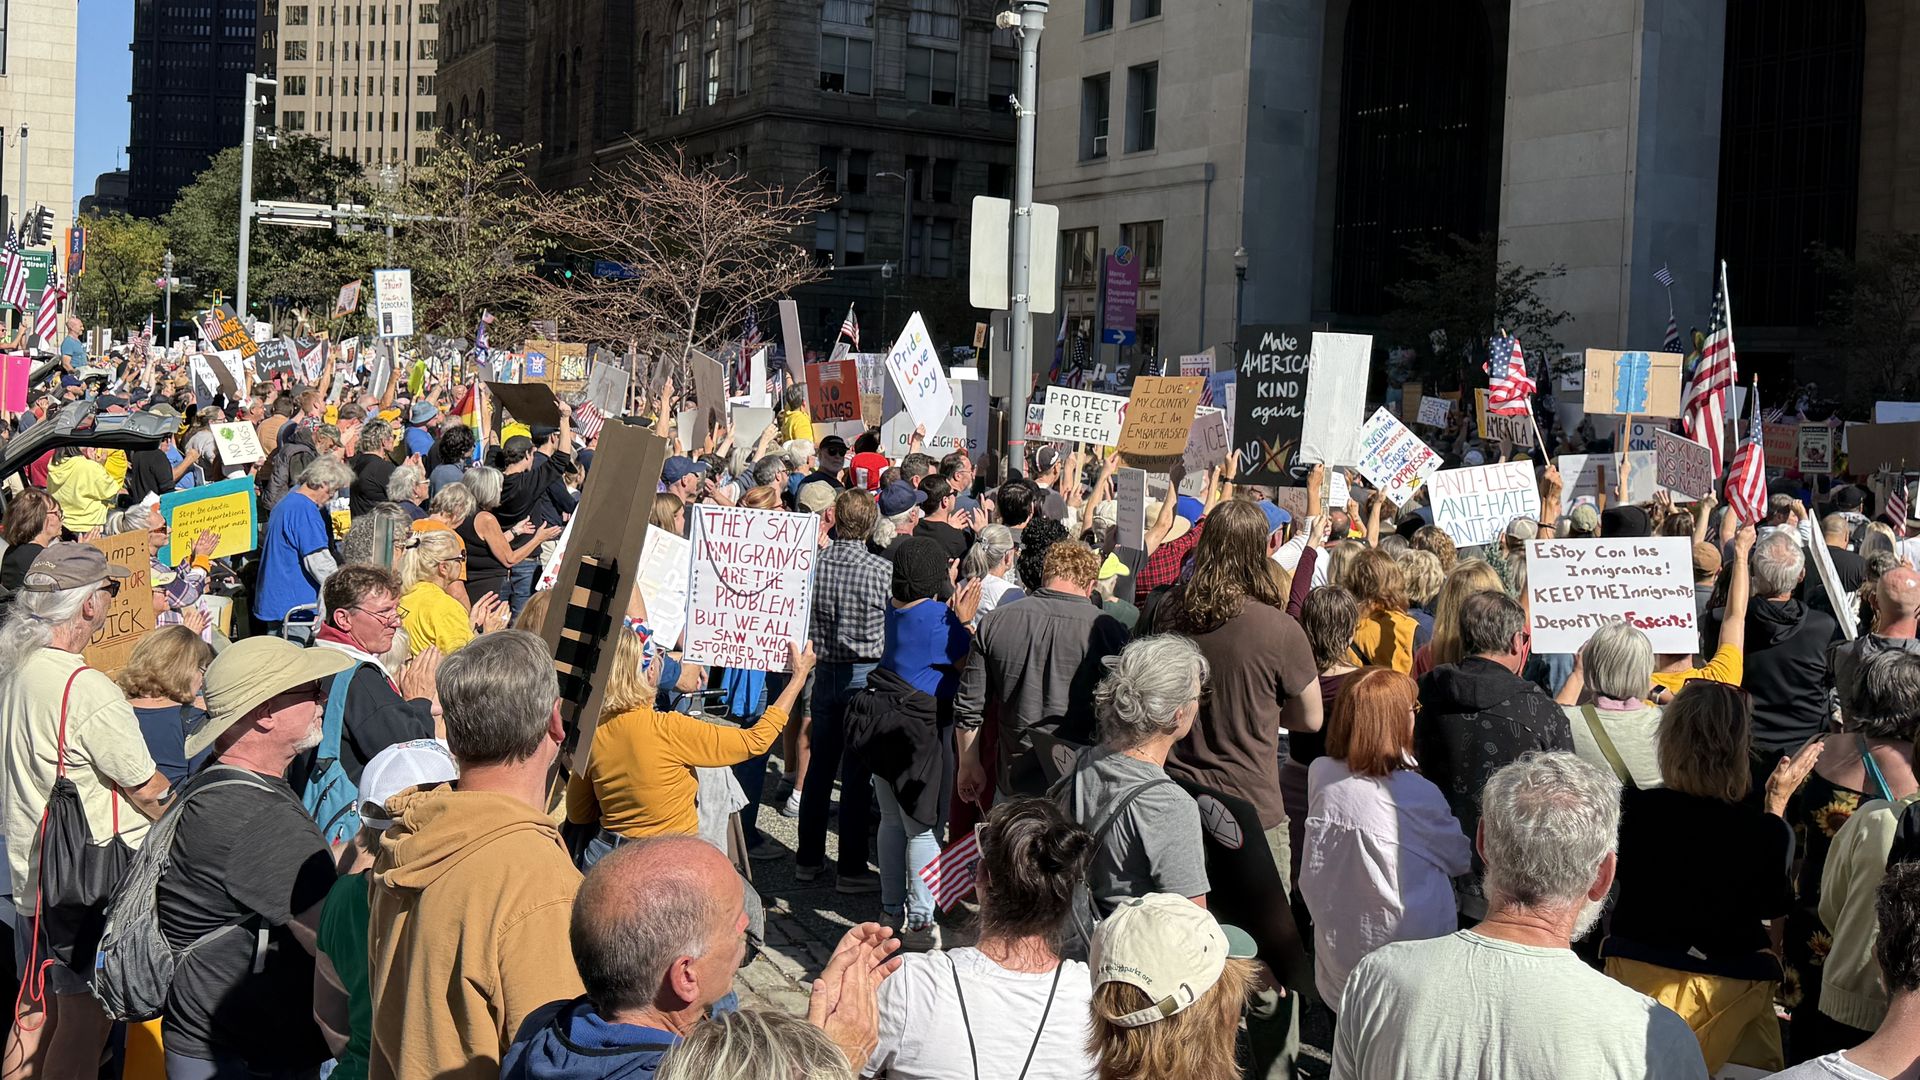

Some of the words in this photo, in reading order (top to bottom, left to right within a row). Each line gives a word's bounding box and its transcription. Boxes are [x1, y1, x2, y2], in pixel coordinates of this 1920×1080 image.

[1108, 270, 1126, 279] Mercy
[1107, 297, 1135, 306] University
[1260, 332, 1298, 350] Make
[894, 332, 922, 371] Pride
[904, 348, 929, 384] Love
[1240, 350, 1310, 378] AMERICA
[820, 386, 840, 402] NO
[1142, 380, 1152, 394] I
[1257, 382, 1298, 398] KIND
[811, 401, 854, 420] KINGS
[1050, 392, 1121, 412] PROTECT
[1135, 398, 1149, 408] MY
[1150, 398, 1189, 408] COUNTRY
[1063, 410, 1102, 424] FREE
[1160, 412, 1167, 424] I
[1053, 424, 1110, 442] SPEECH
[1203, 423, 1226, 452] ICE
[1368, 420, 1397, 448] NEUTRAL
[1486, 416, 1528, 445] AMERICA
[236, 425, 258, 456] KINGS
[1138, 441, 1150, 450] BY
[1154, 442, 1168, 450] THE
[1376, 428, 1408, 458] INJUSTICE
[1628, 438, 1657, 451] KING
[1657, 435, 1676, 454] NO
[228, 444, 244, 458] NO
[1239, 440, 1260, 472] NO
[1385, 438, 1414, 470] CHOSEN
[1658, 450, 1676, 471] NO
[1391, 446, 1434, 490] OPPRESSOR
[1658, 468, 1676, 487] NO
[1435, 460, 1531, 498] ANTI-LIES
[179, 510, 195, 518] Stop
[1438, 488, 1536, 522] ANTI-HATE
[705, 512, 755, 538] THEY
[764, 518, 802, 543] SAY
[698, 539, 812, 571] IMMIGRANTS
[1534, 542, 1586, 561] Estoy
[1595, 546, 1626, 558] Con
[1634, 546, 1659, 557] las
[720, 566, 748, 585] ARE
[754, 569, 784, 590] THE
[1566, 562, 1670, 578] Inmigrantes!
[716, 586, 797, 618] PROBLEM.
[1534, 586, 1584, 603] KEEP
[1586, 584, 1619, 600] THE
[695, 609, 727, 627] BUT
[734, 614, 760, 631] WE
[764, 618, 792, 637] ALL
[1534, 614, 1590, 630] Deport
[1624, 611, 1693, 630] Fascists!
[712, 629, 747, 644] SAW
[756, 635, 789, 652] WHO
[692, 640, 754, 658] STORMED
[763, 649, 789, 664] THE
[714, 656, 772, 671] CAPITOL
